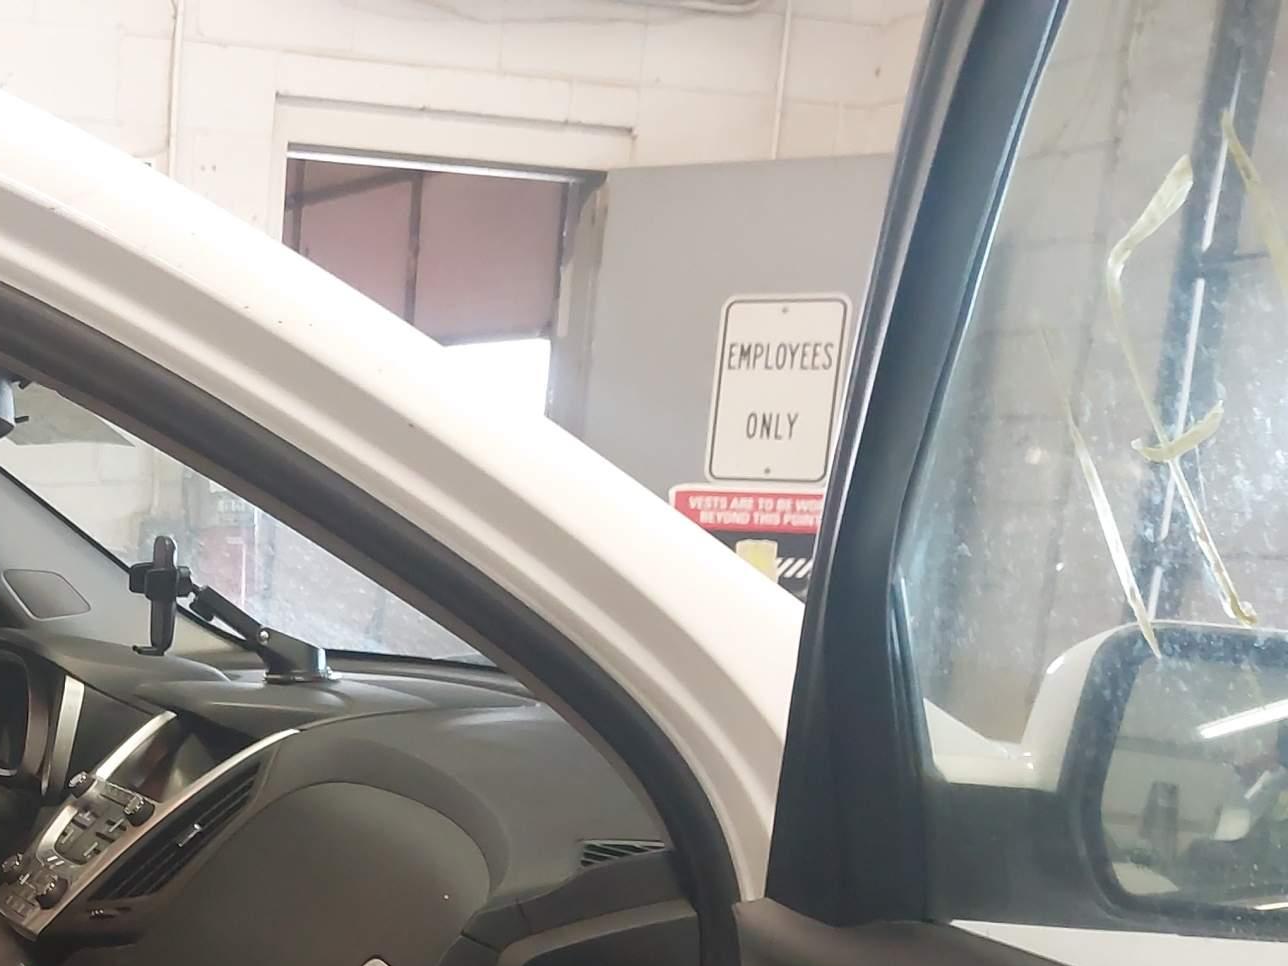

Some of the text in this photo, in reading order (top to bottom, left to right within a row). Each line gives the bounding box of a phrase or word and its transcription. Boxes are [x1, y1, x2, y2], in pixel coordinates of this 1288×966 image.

[726, 341, 834, 371] EMPLOYEES
[746, 412, 799, 440] ONLY
[689, 496, 727, 509] VESTS
[730, 497, 754, 511] ARE
[758, 499, 774, 511] TO
[776, 499, 793, 512] BE
[700, 511, 750, 524] BEYOND
[753, 512, 781, 525] THIS
